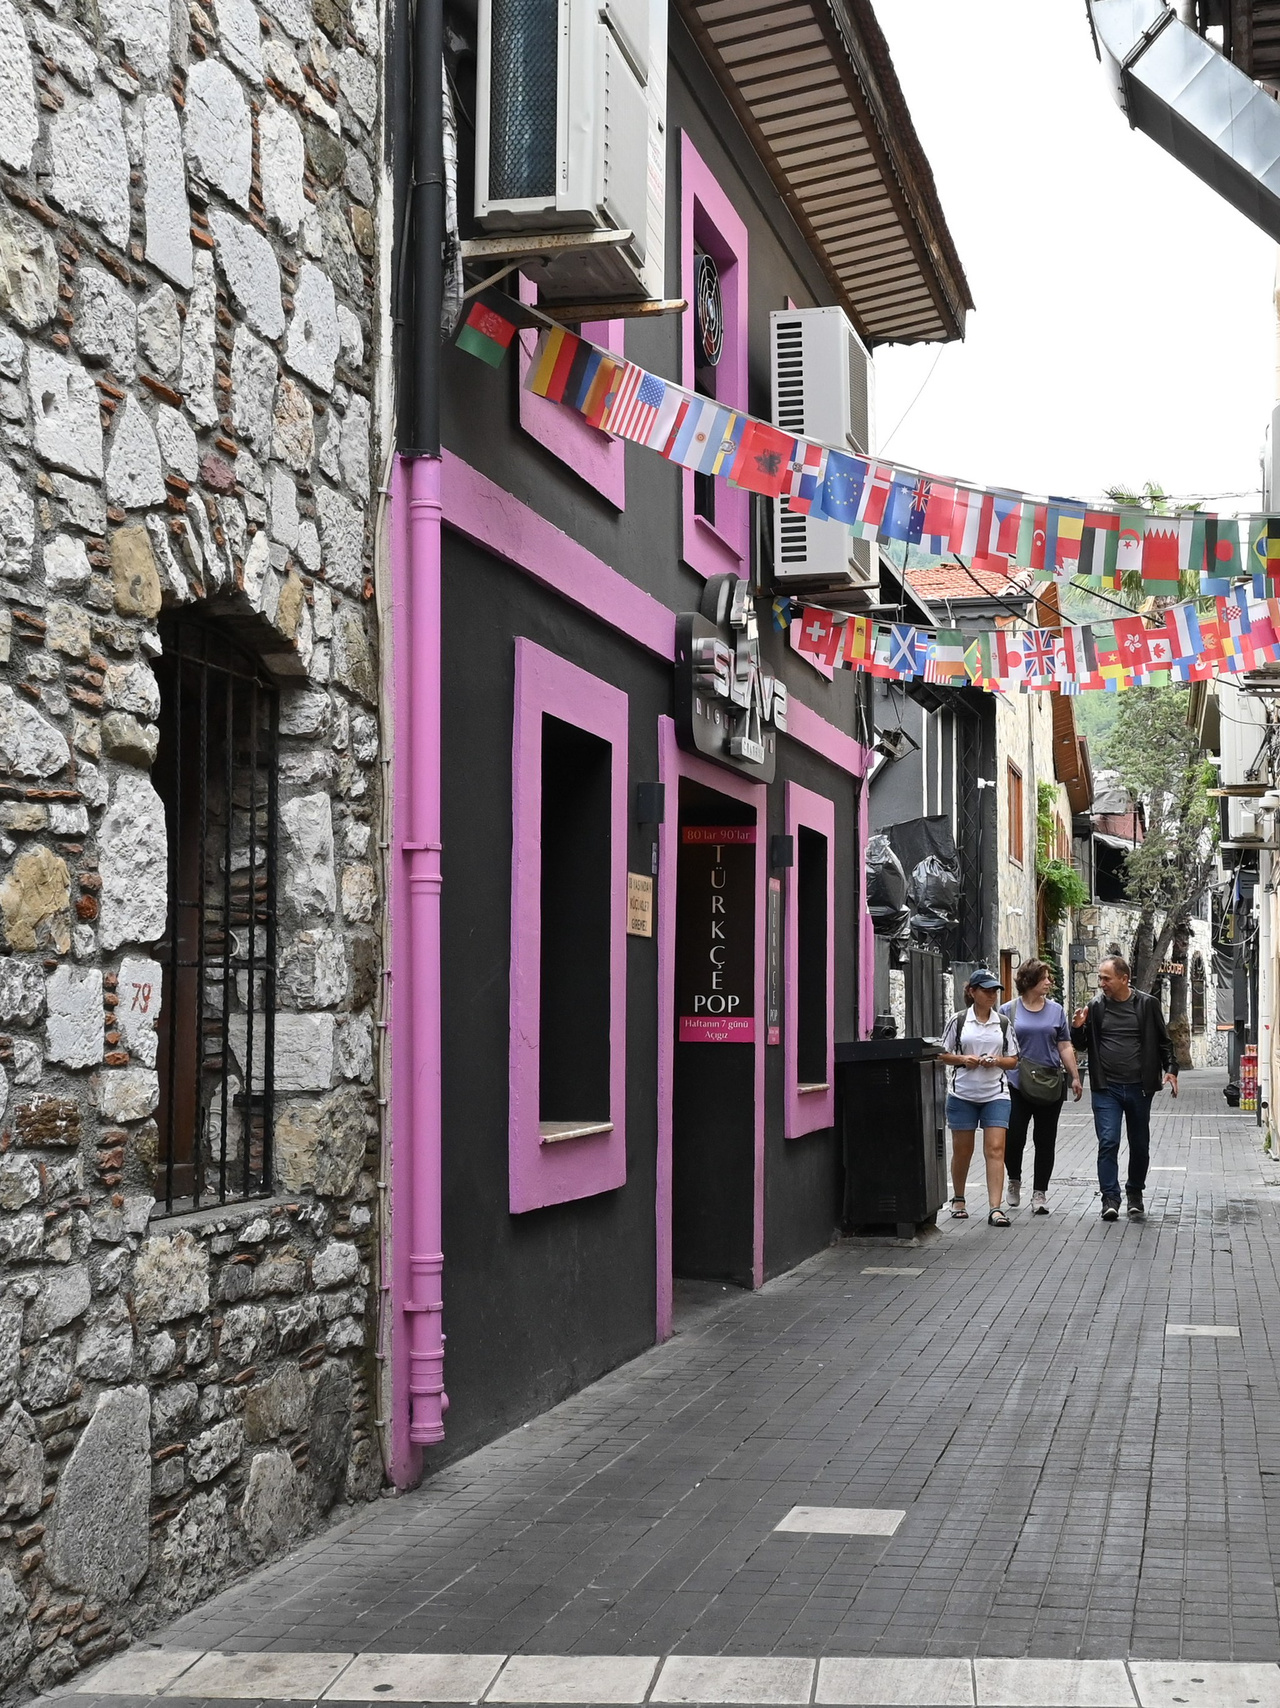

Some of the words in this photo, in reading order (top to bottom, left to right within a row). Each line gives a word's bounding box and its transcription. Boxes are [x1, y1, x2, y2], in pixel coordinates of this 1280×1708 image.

[709, 844, 727, 990] TÜRKÇE
[131, 983, 151, 1014] 79
[694, 994, 740, 1014] POP
[721, 1019, 727, 1028] 7
